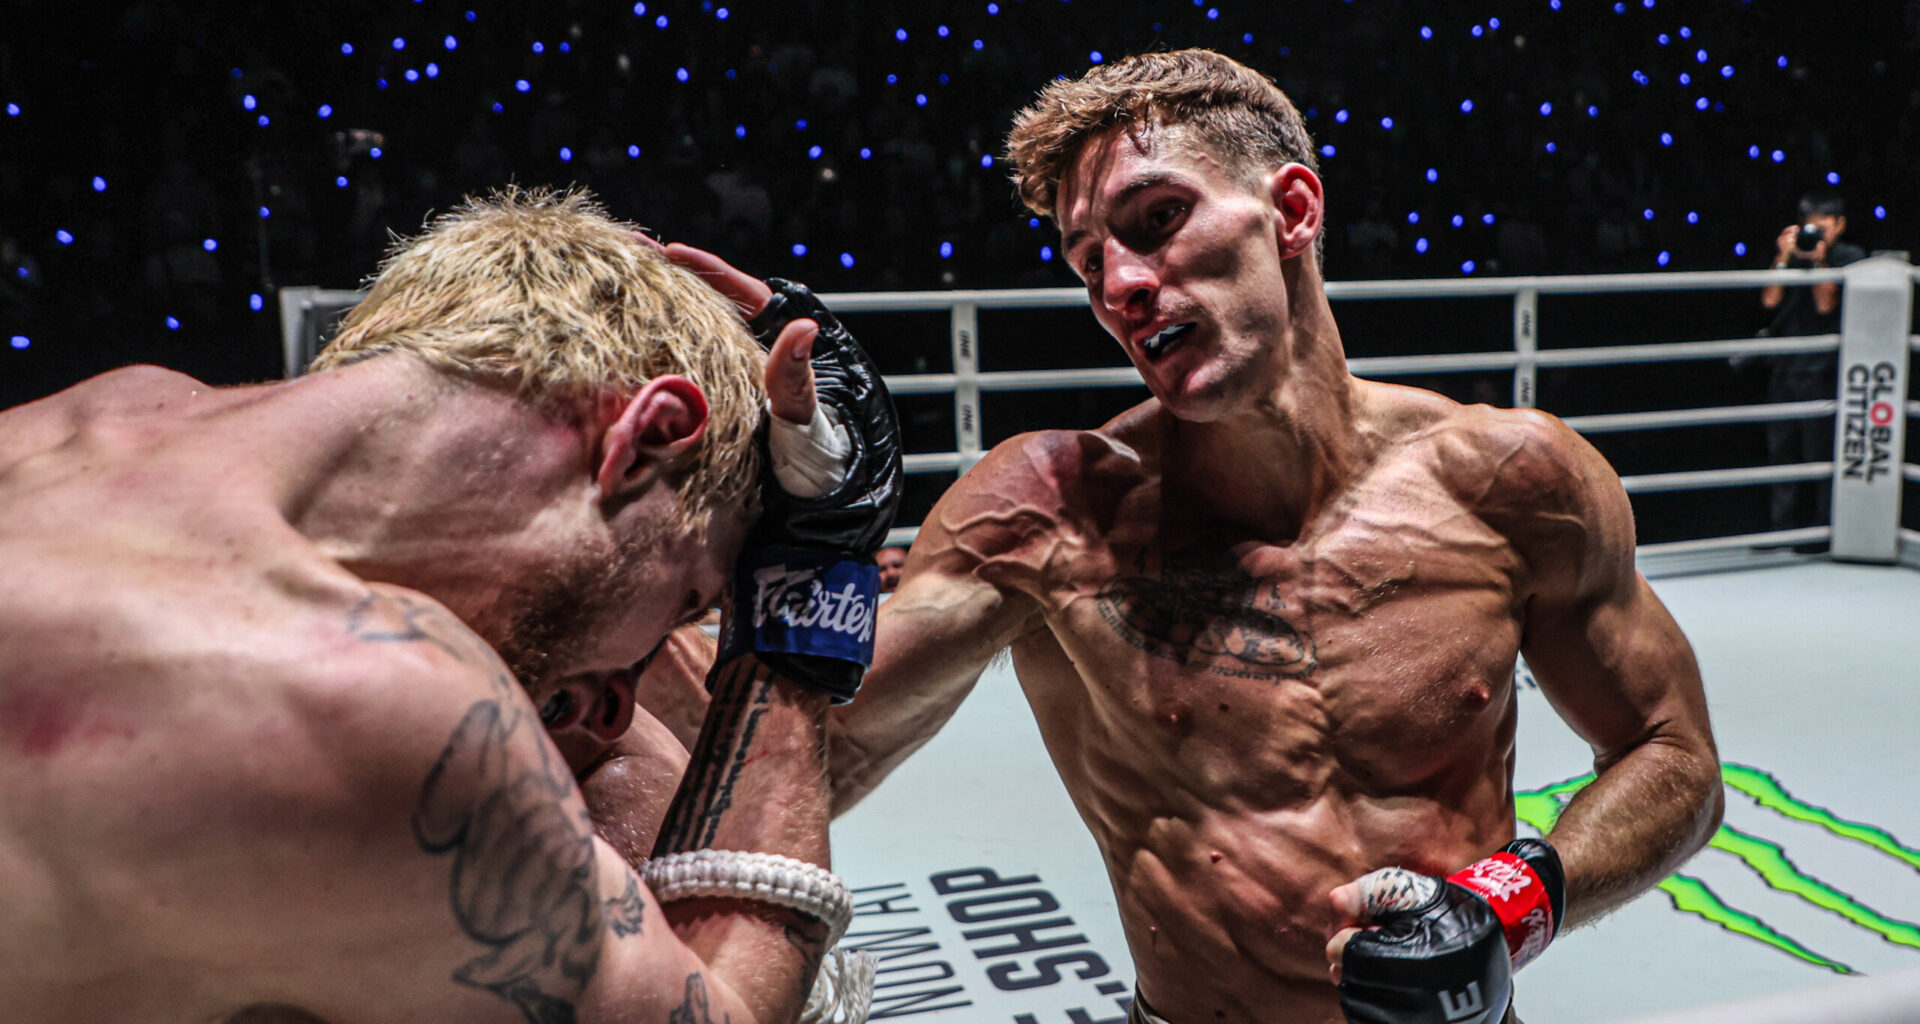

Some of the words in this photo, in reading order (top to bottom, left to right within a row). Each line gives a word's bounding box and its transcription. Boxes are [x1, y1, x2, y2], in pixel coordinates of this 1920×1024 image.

[1843, 363, 1870, 481] CITIZEN
[1866, 361, 1896, 483] GLOBAL
[839, 926, 974, 1020] NOW
